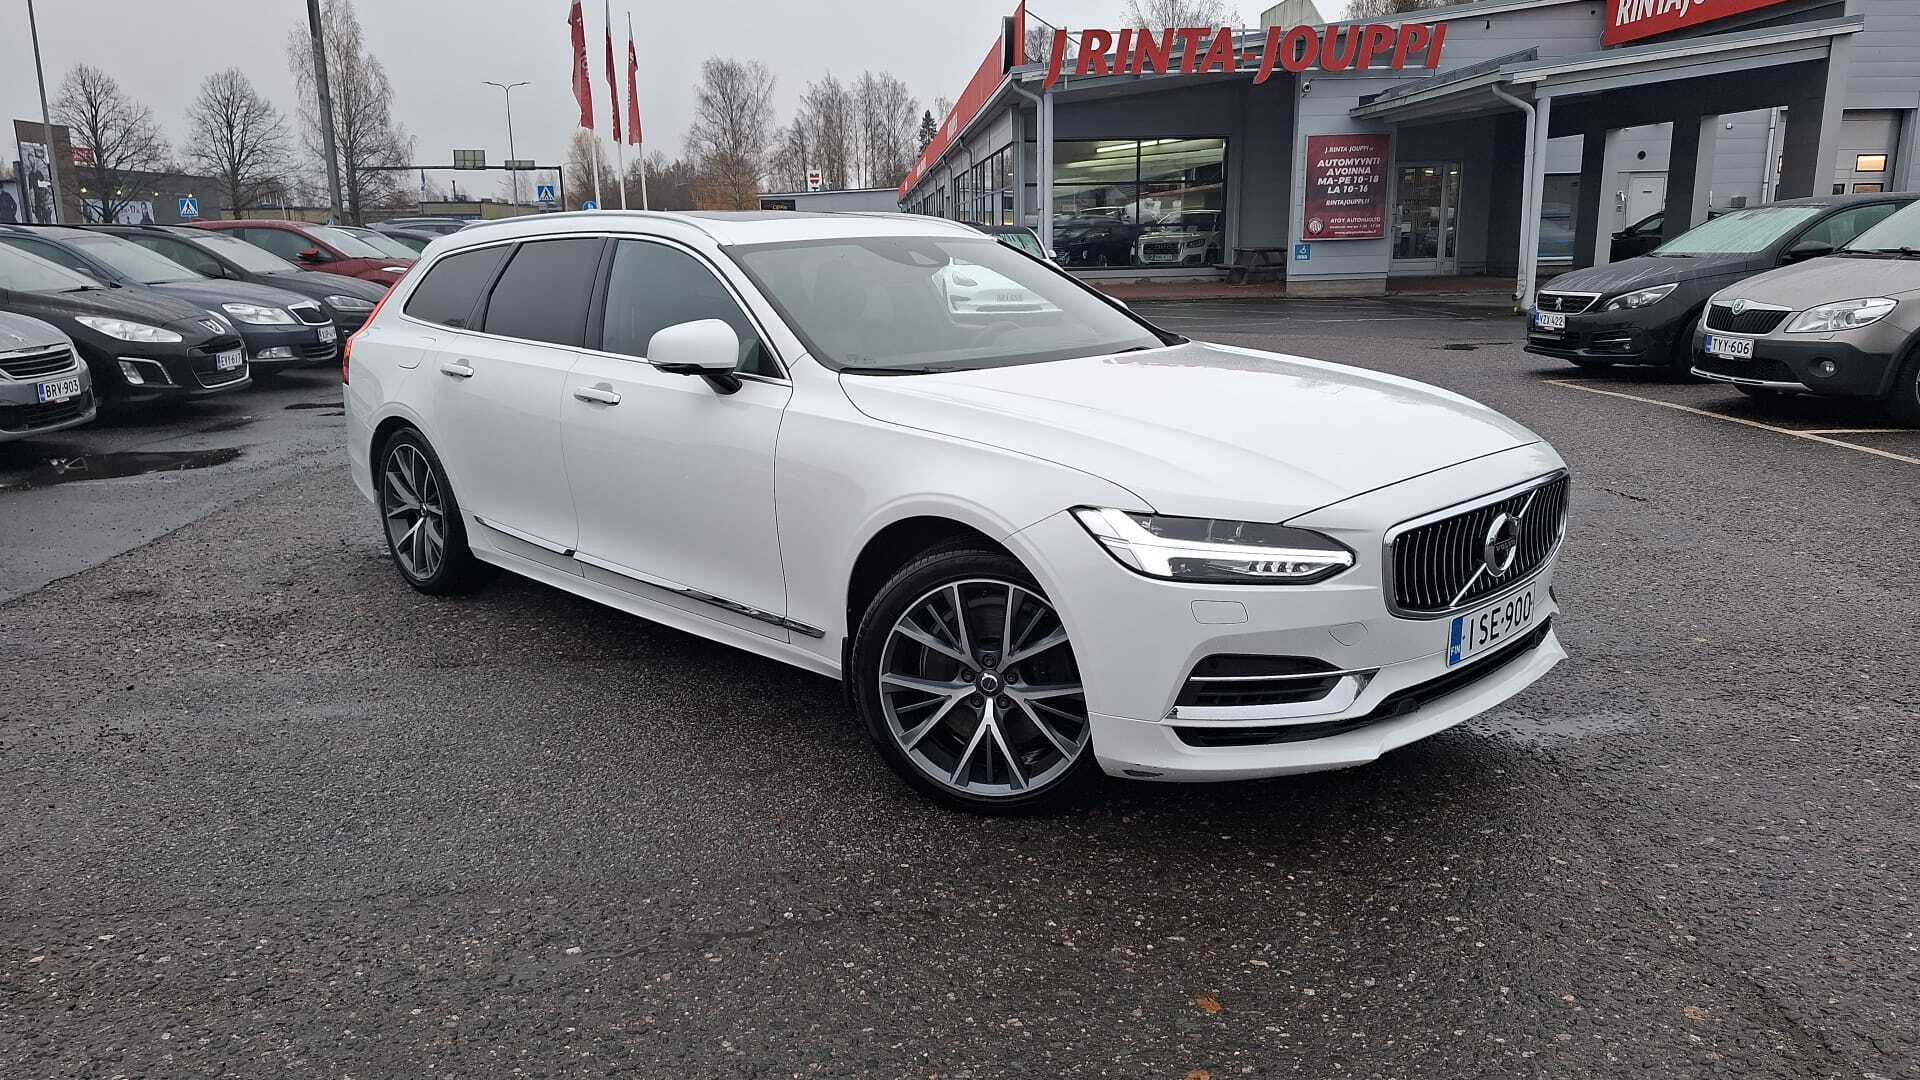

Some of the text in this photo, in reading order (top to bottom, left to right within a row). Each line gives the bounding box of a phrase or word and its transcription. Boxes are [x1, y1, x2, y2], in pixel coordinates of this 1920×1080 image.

[1317, 157, 1380, 167] AUTOMYYNTI
[1326, 167, 1371, 176] AVOINNA
[1317, 176, 1352, 185] MA-PE
[1327, 186, 1340, 194] LA
[1713, 338, 1750, 354] TYY-606
